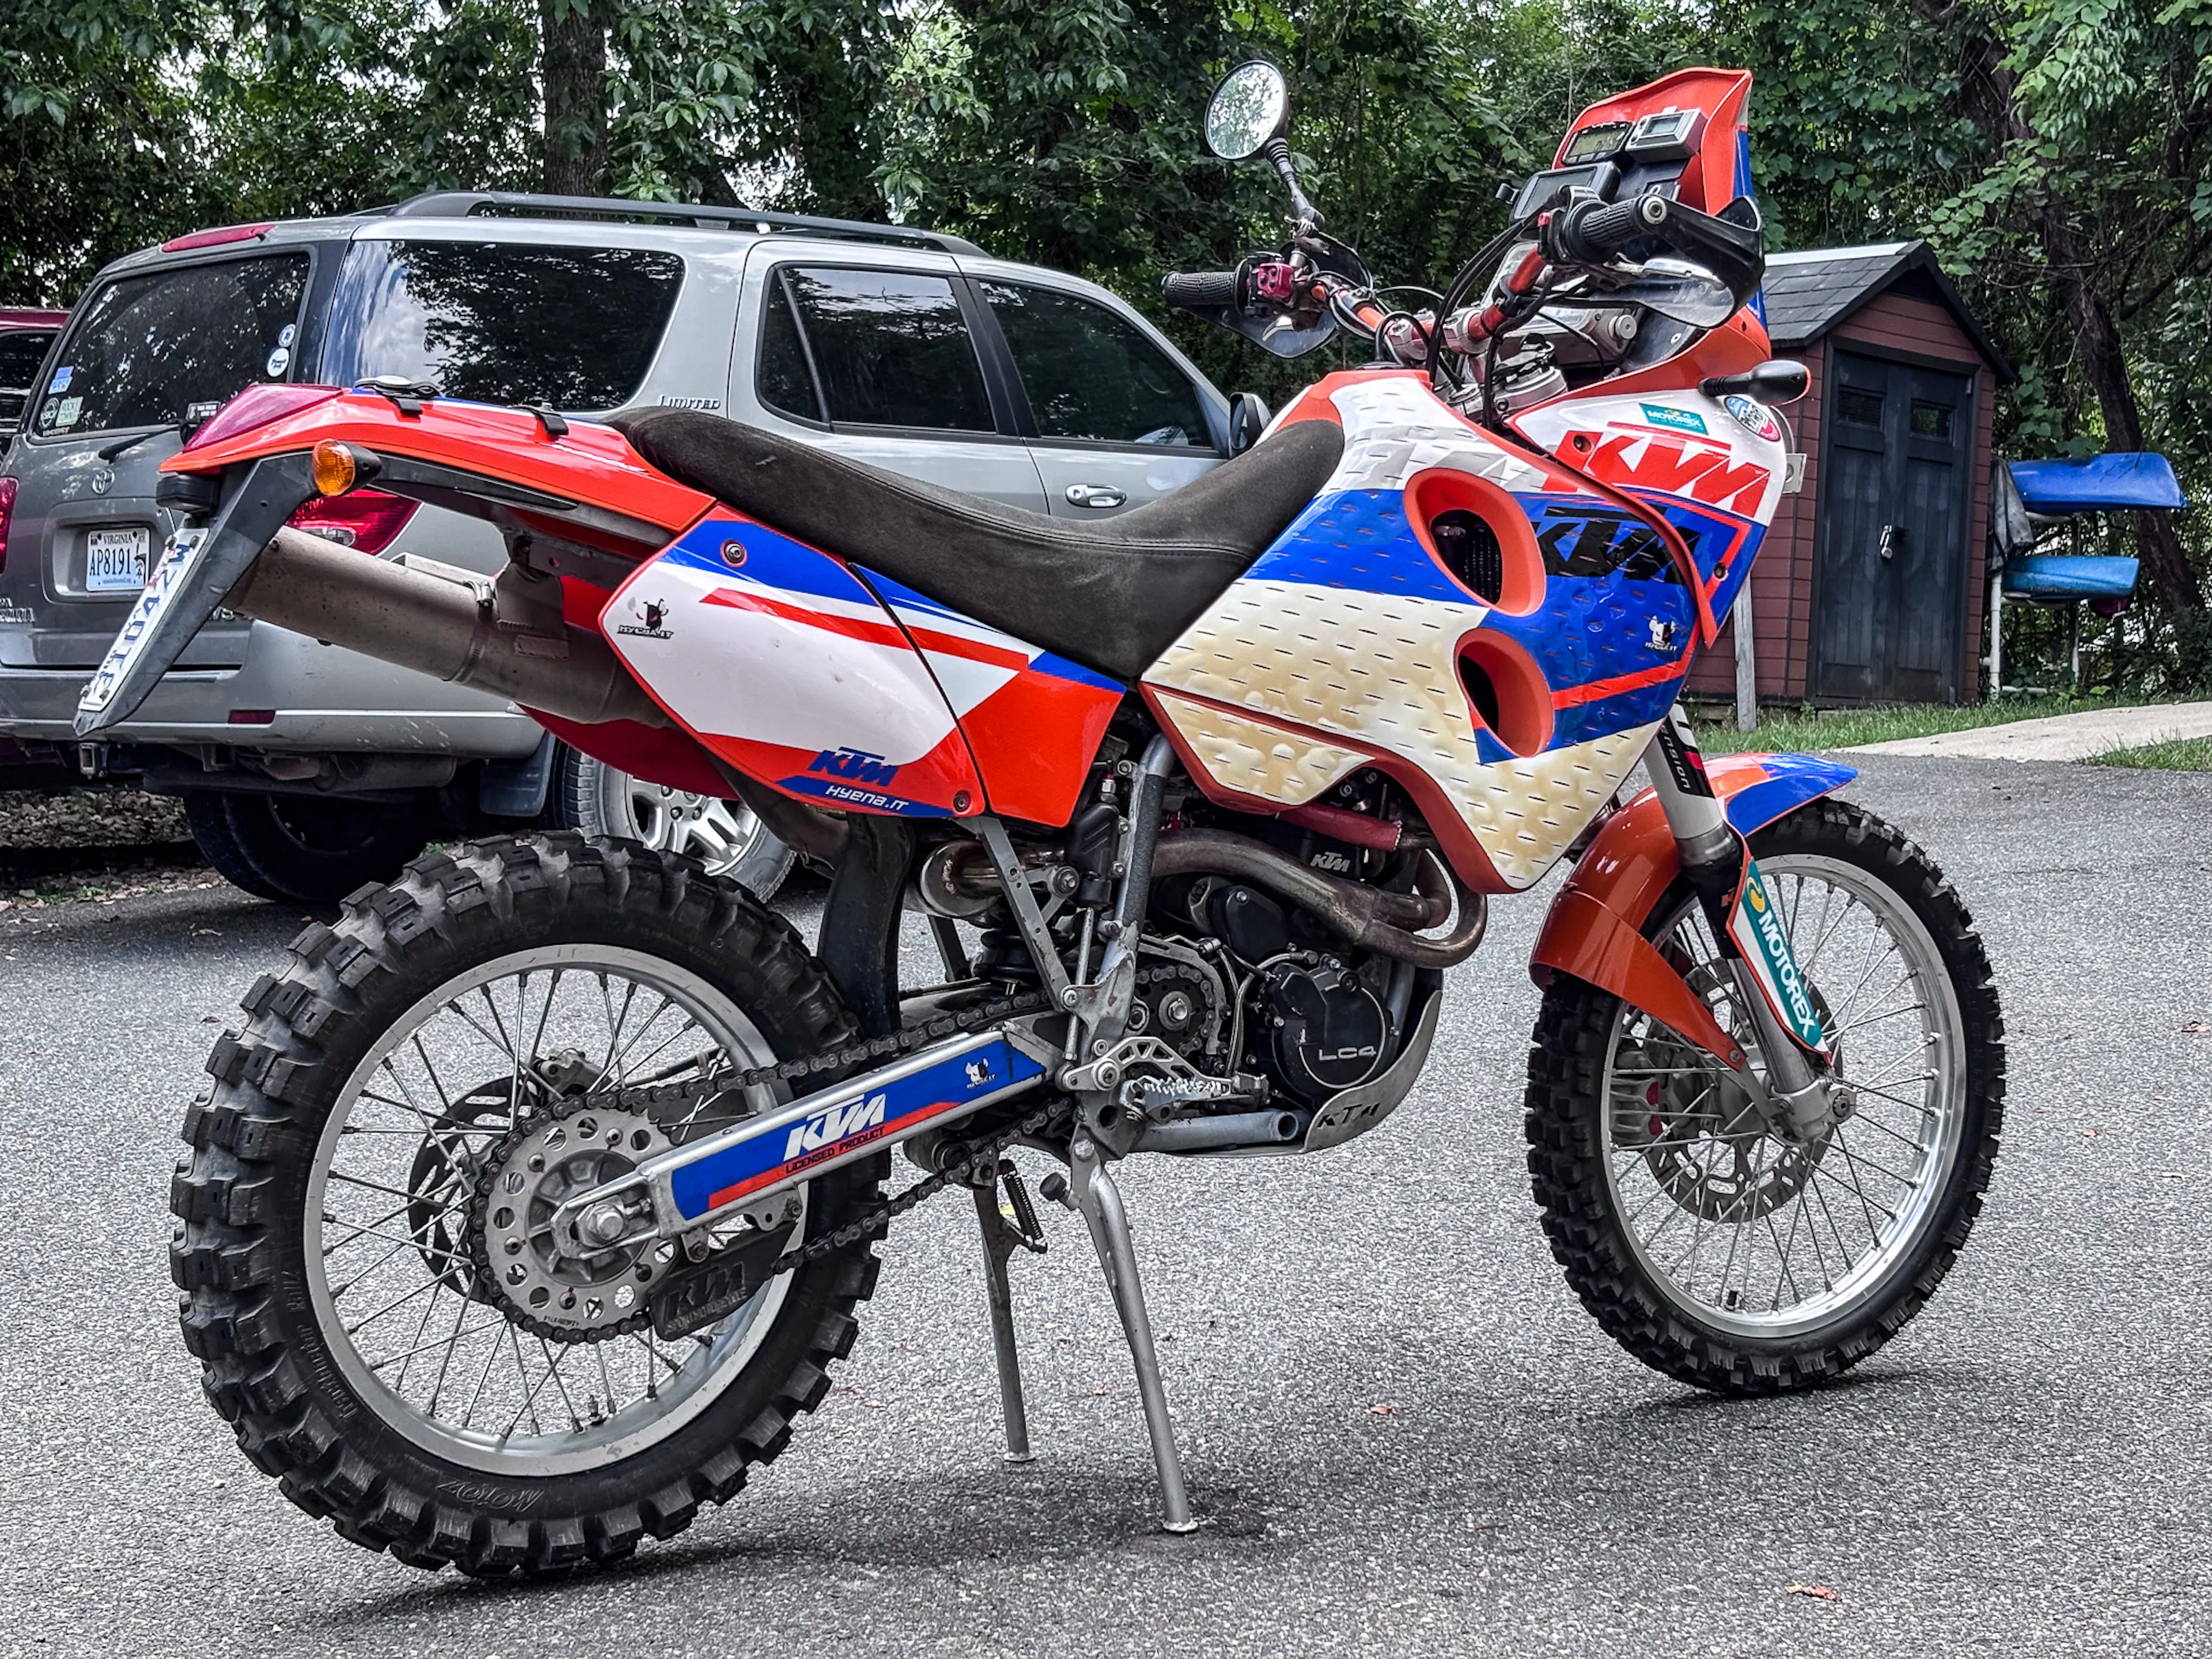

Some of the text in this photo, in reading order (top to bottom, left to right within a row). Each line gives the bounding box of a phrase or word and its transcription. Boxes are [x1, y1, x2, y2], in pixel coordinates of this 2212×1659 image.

[657, 394, 721, 410] LIMITED
[1647, 410, 1702, 427] MOTOREX
[1542, 422, 1771, 518] KTM
[103, 533, 132, 544] VIRGINIA
[1530, 502, 1701, 585] KTM
[89, 547, 131, 576] AP8191
[808, 746, 899, 787] KTM
[1310, 851, 1351, 873] KTM
[1758, 909, 1816, 1037] MOTOREX
[1319, 1046, 1377, 1062] LC4
[783, 1093, 887, 1162] KTM
[1316, 1102, 1381, 1128] KTM
[786, 1126, 885, 1174] LICENSED PRODUCT
[664, 1260, 745, 1323] KTM
